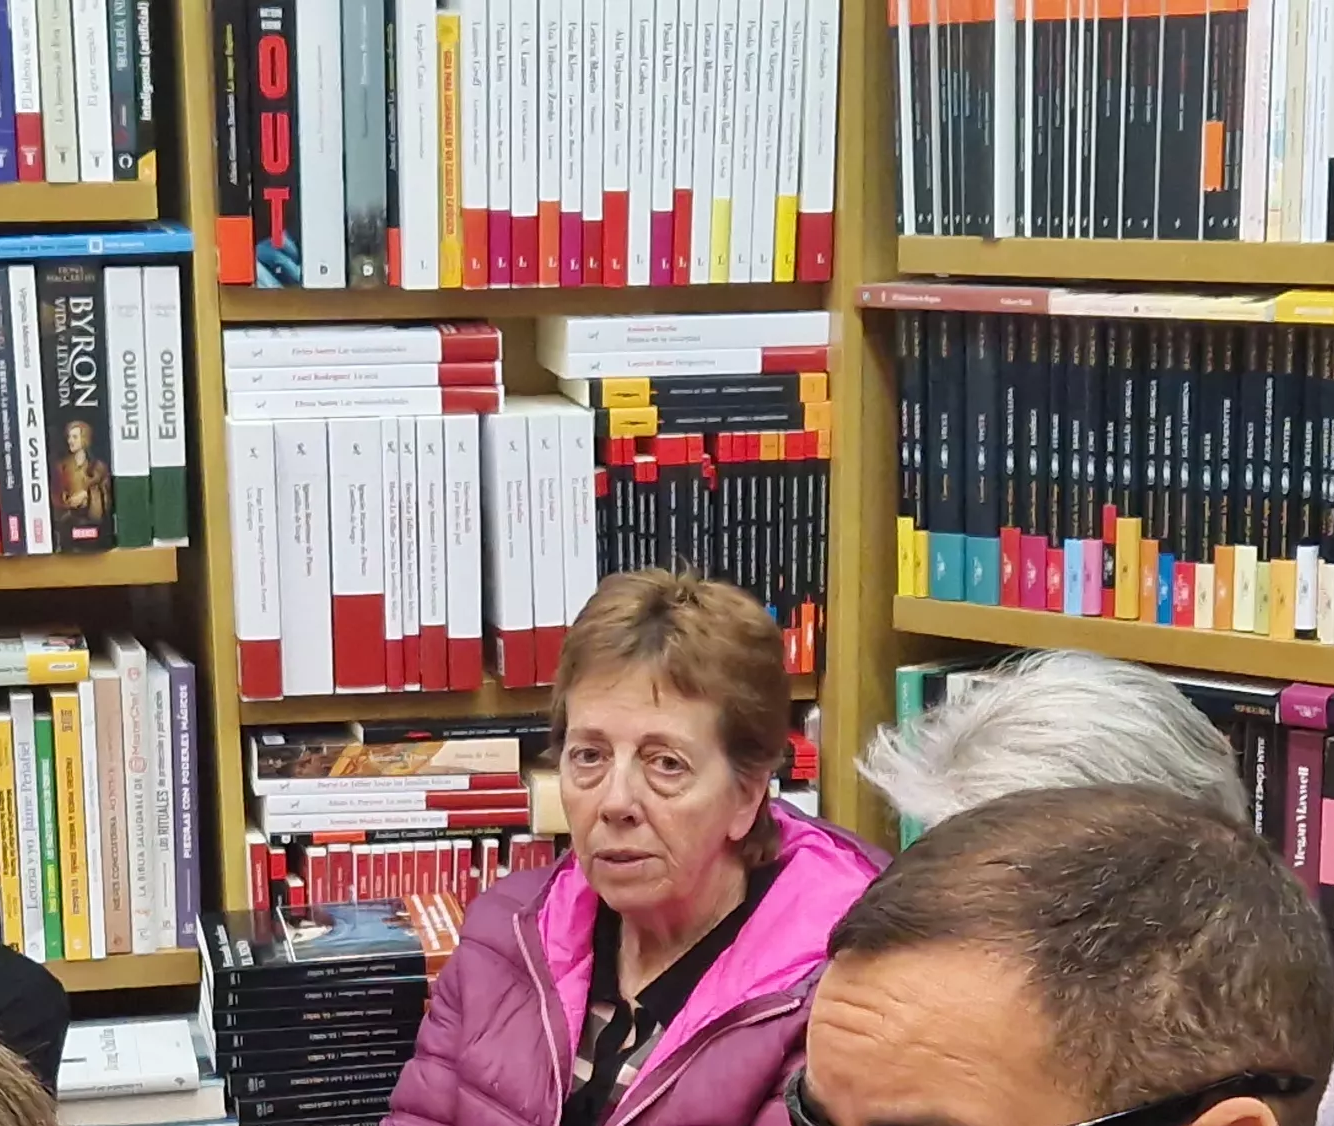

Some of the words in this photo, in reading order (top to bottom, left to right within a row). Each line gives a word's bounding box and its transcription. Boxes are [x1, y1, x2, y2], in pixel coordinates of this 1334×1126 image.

[53, 297, 66, 332] VIDA
[63, 295, 102, 409] BYRON
[56, 344, 70, 407] LEYENDA
[119, 350, 139, 440] Entorno
[157, 349, 176, 439] Entorno
[25, 437, 43, 503] SED
[177, 684, 188, 730] MÁGICOS
[16, 741, 33, 791] Peñafiel
[180, 732, 190, 784] PODERES
[133, 778, 142, 789] DE
[181, 787, 190, 810] CON
[1294, 765, 1309, 820] Maxwell
[19, 796, 34, 831] Jaime
[133, 793, 144, 847] SALUDABLE
[181, 812, 191, 858] PIEDRAS
[25, 839, 36, 855] yo
[135, 851, 146, 881] BIBLIA
[1292, 823, 1306, 866] Megan
[24, 868, 39, 910] Letizia
[137, 884, 146, 896] LA
